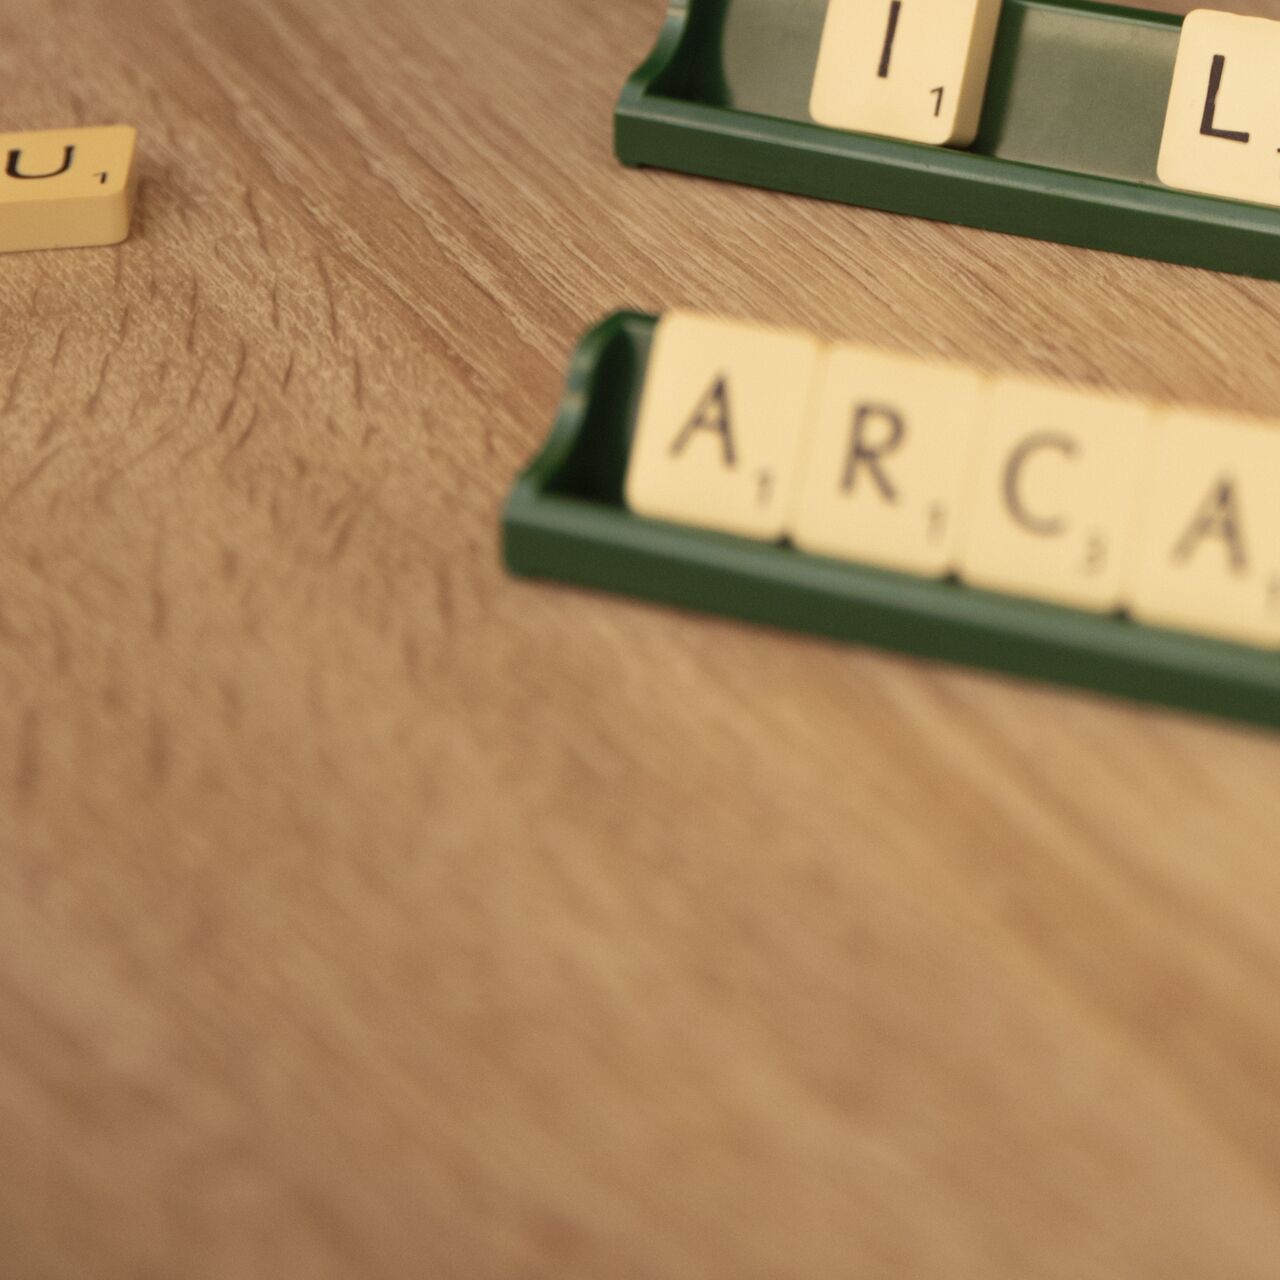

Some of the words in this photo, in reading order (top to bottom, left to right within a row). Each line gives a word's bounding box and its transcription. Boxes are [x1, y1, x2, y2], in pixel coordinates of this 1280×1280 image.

[876, 0, 902, 79] I
[929, 85, 945, 118] 1
[5, 143, 76, 180] U
